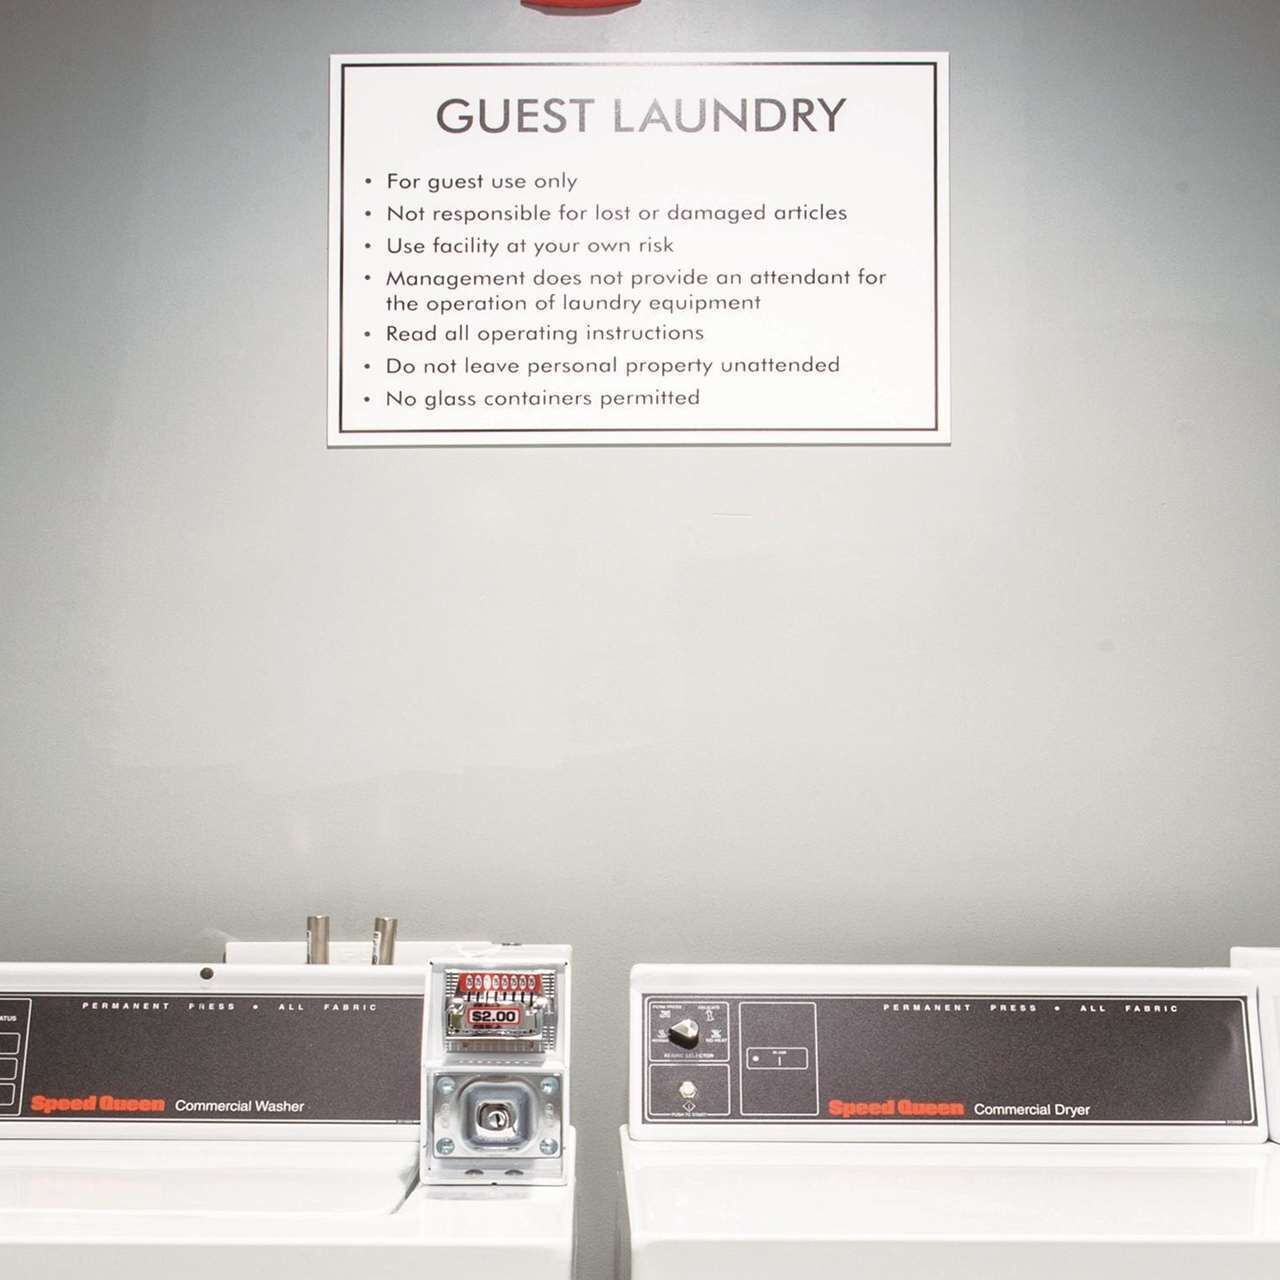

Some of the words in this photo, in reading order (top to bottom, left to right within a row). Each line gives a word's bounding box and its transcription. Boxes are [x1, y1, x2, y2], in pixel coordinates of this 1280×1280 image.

[436, 98, 595, 134] GUEST
[614, 97, 847, 133] LAUNDRY
[387, 172, 421, 190] For
[427, 174, 484, 193] guest
[491, 177, 526, 189] use
[534, 171, 577, 193] only
[387, 205, 425, 222] Not
[433, 204, 551, 225] responsible
[559, 203, 587, 221] for
[596, 204, 630, 221] lost
[638, 209, 657, 220] or
[667, 203, 766, 225] damaged
[774, 203, 848, 221] articles
[387, 237, 425, 254] Use
[432, 236, 500, 257] facility
[506, 239, 526, 254] at
[534, 242, 580, 257] your
[587, 241, 630, 253] own
[639, 236, 673, 253] risk
[386, 271, 525, 290] Management
[533, 269, 582, 286] does
[590, 271, 622, 285] not
[631, 268, 708, 289] provide
[716, 273, 742, 285] an
[750, 268, 850, 285] attendant
[858, 267, 887, 285] for
[386, 294, 419, 312] the
[426, 294, 527, 315] operation
[535, 293, 555, 311] of
[563, 293, 641, 314] laundry
[649, 294, 761, 314] equipment
[386, 324, 437, 342] Read
[445, 324, 469, 342] all
[477, 324, 578, 345] operating
[587, 324, 704, 341] instructions
[386, 357, 416, 374] Do
[424, 359, 457, 374] not
[465, 356, 520, 374] leave
[528, 356, 617, 377] personal
[626, 358, 713, 377] property
[721, 355, 840, 373] unattended
[386, 390, 417, 407] No
[424, 389, 477, 411] glass
[484, 391, 592, 407] containers
[600, 388, 700, 409] permitted
[82, 1002, 170, 1010] PERMANENT
[278, 1003, 304, 1011] ALL
[323, 1003, 377, 1011] FABRIC
[883, 1003, 971, 1011] PERMANENT
[990, 1004, 1037, 1012] PRESS
[1125, 1005, 1178, 1013] FABRIC
[31, 1094, 97, 1114] Speed
[98, 1095, 166, 1113] Queen
[175, 1099, 252, 1113] Commercial
[255, 1099, 305, 1113] Washer
[828, 1099, 895, 1119] Speed
[897, 1099, 966, 1116] Queen
[974, 1103, 1051, 1116] Commercial
[1054, 1103, 1091, 1118] Dryer
